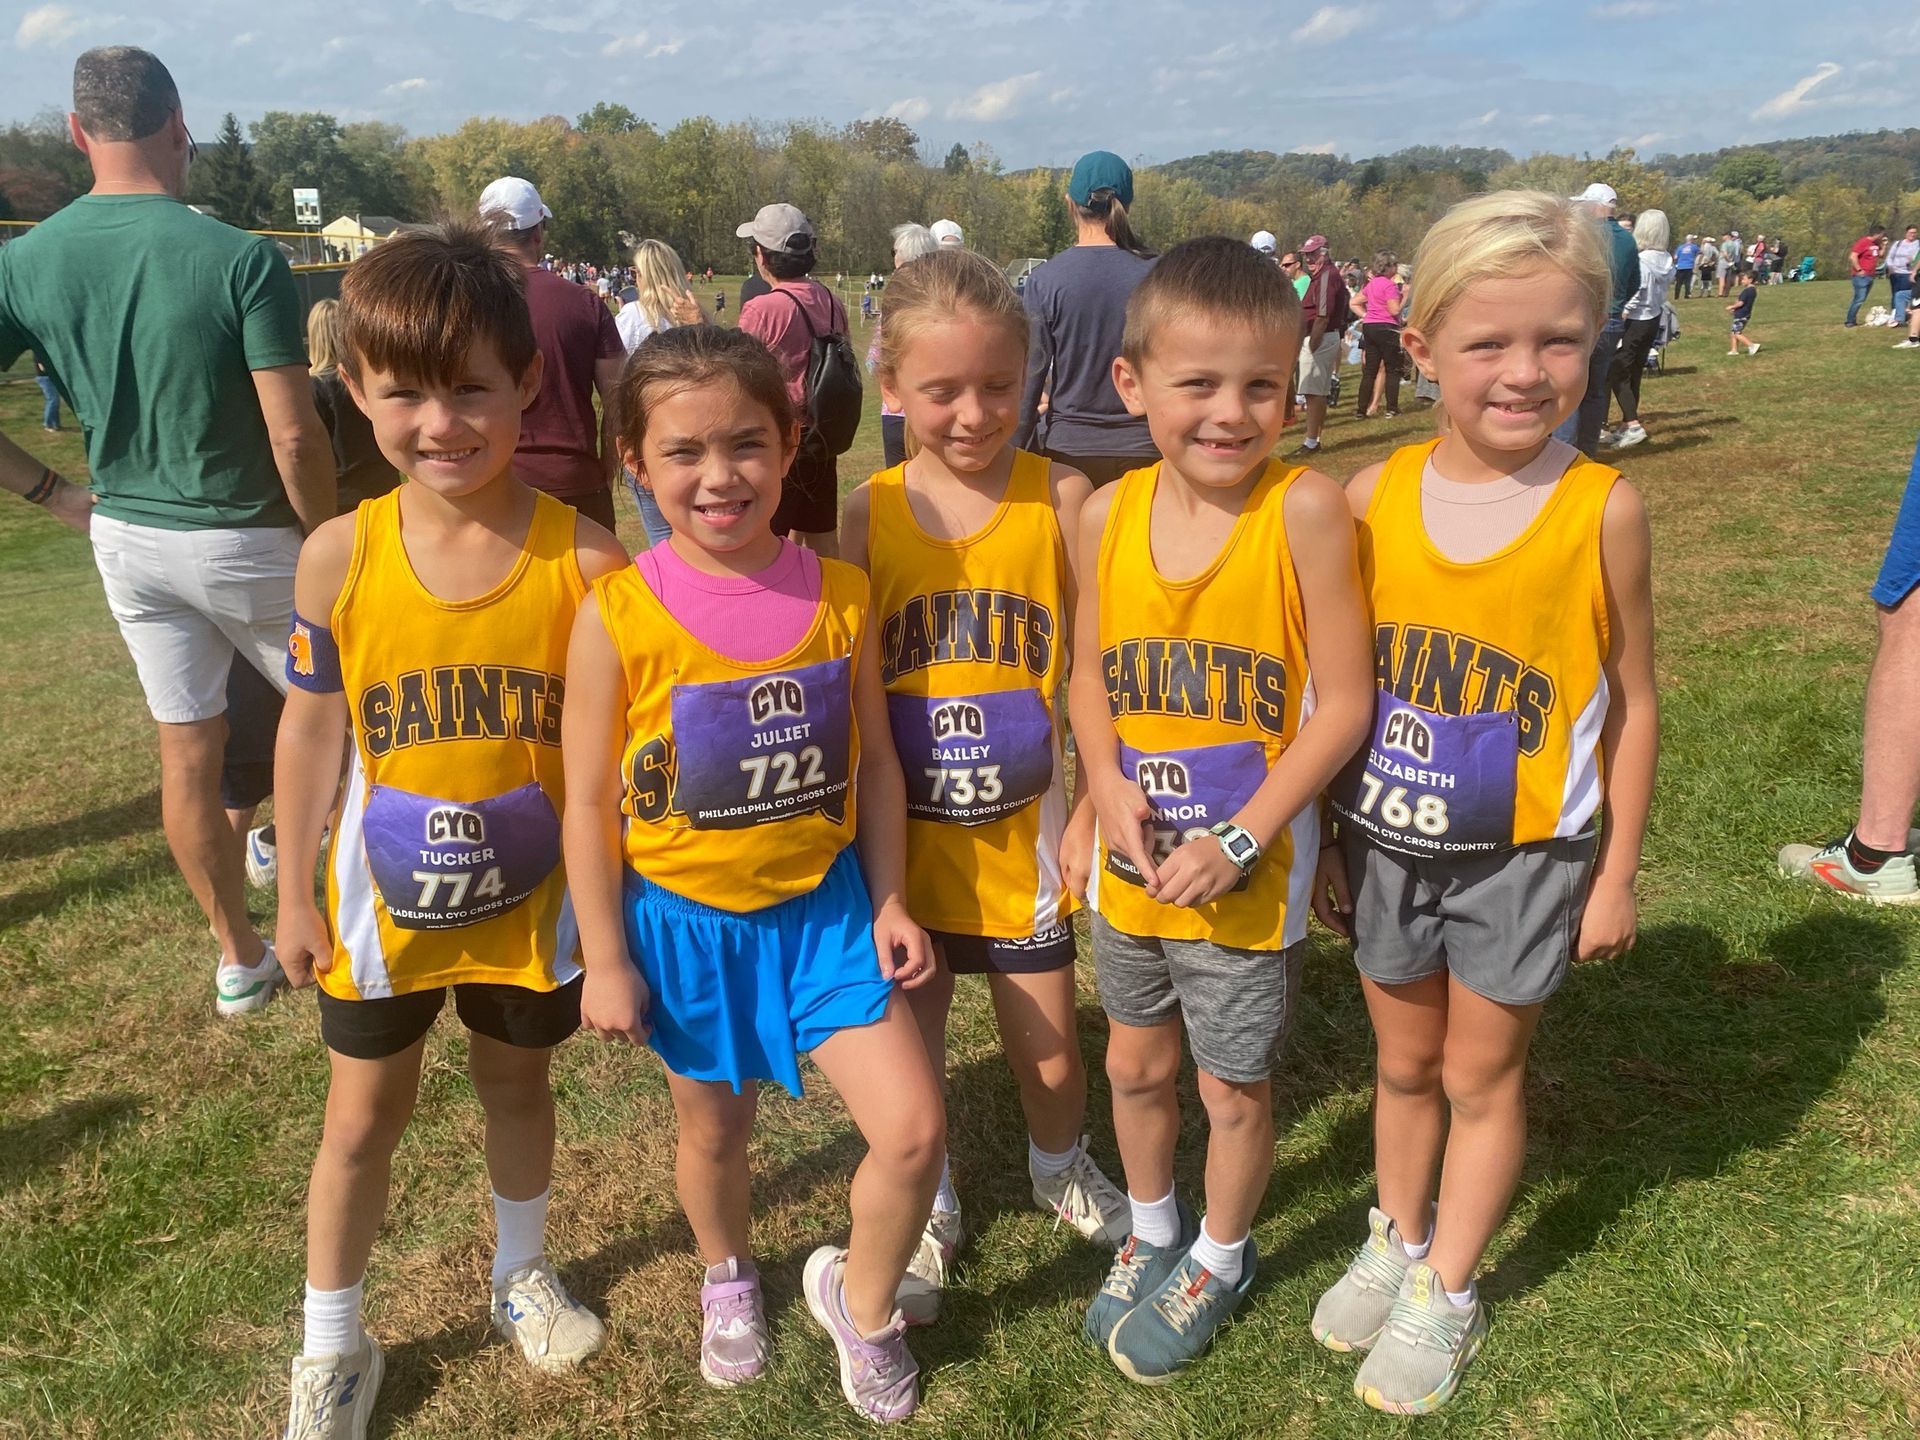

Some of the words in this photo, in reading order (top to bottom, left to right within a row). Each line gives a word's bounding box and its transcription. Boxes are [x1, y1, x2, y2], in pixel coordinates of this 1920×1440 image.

[882, 588, 1053, 686] SAINTS
[750, 678, 804, 725] CYO
[1376, 622, 1556, 758] AINTS
[751, 723, 811, 748] JULIET
[934, 704, 983, 739] CYO
[1384, 711, 1431, 761] CYO
[931, 744, 991, 761] BAILEY
[1368, 747, 1456, 788] ELIZABETH
[739, 745, 826, 800] 722
[924, 764, 1004, 805] 733
[1137, 759, 1188, 795] CYO
[698, 801, 774, 820] PHILADELPHIA
[775, 797, 795, 808] CYO
[796, 787, 825, 804] CROSS
[951, 809, 971, 817] CYO
[971, 804, 1001, 816] CROSS
[1150, 803, 1208, 821] NNOR
[1361, 769, 1450, 836] 768
[428, 808, 483, 843] CYO
[1331, 799, 1380, 834] PHILADELPHIA
[1381, 828, 1402, 841] CYO
[1403, 834, 1441, 850] CROSS
[1443, 842, 1497, 852] COUNTRY
[419, 848, 496, 866] TUCKER
[412, 866, 506, 908] 774
[445, 910, 467, 920] CYO
[469, 900, 503, 915] CROSS
